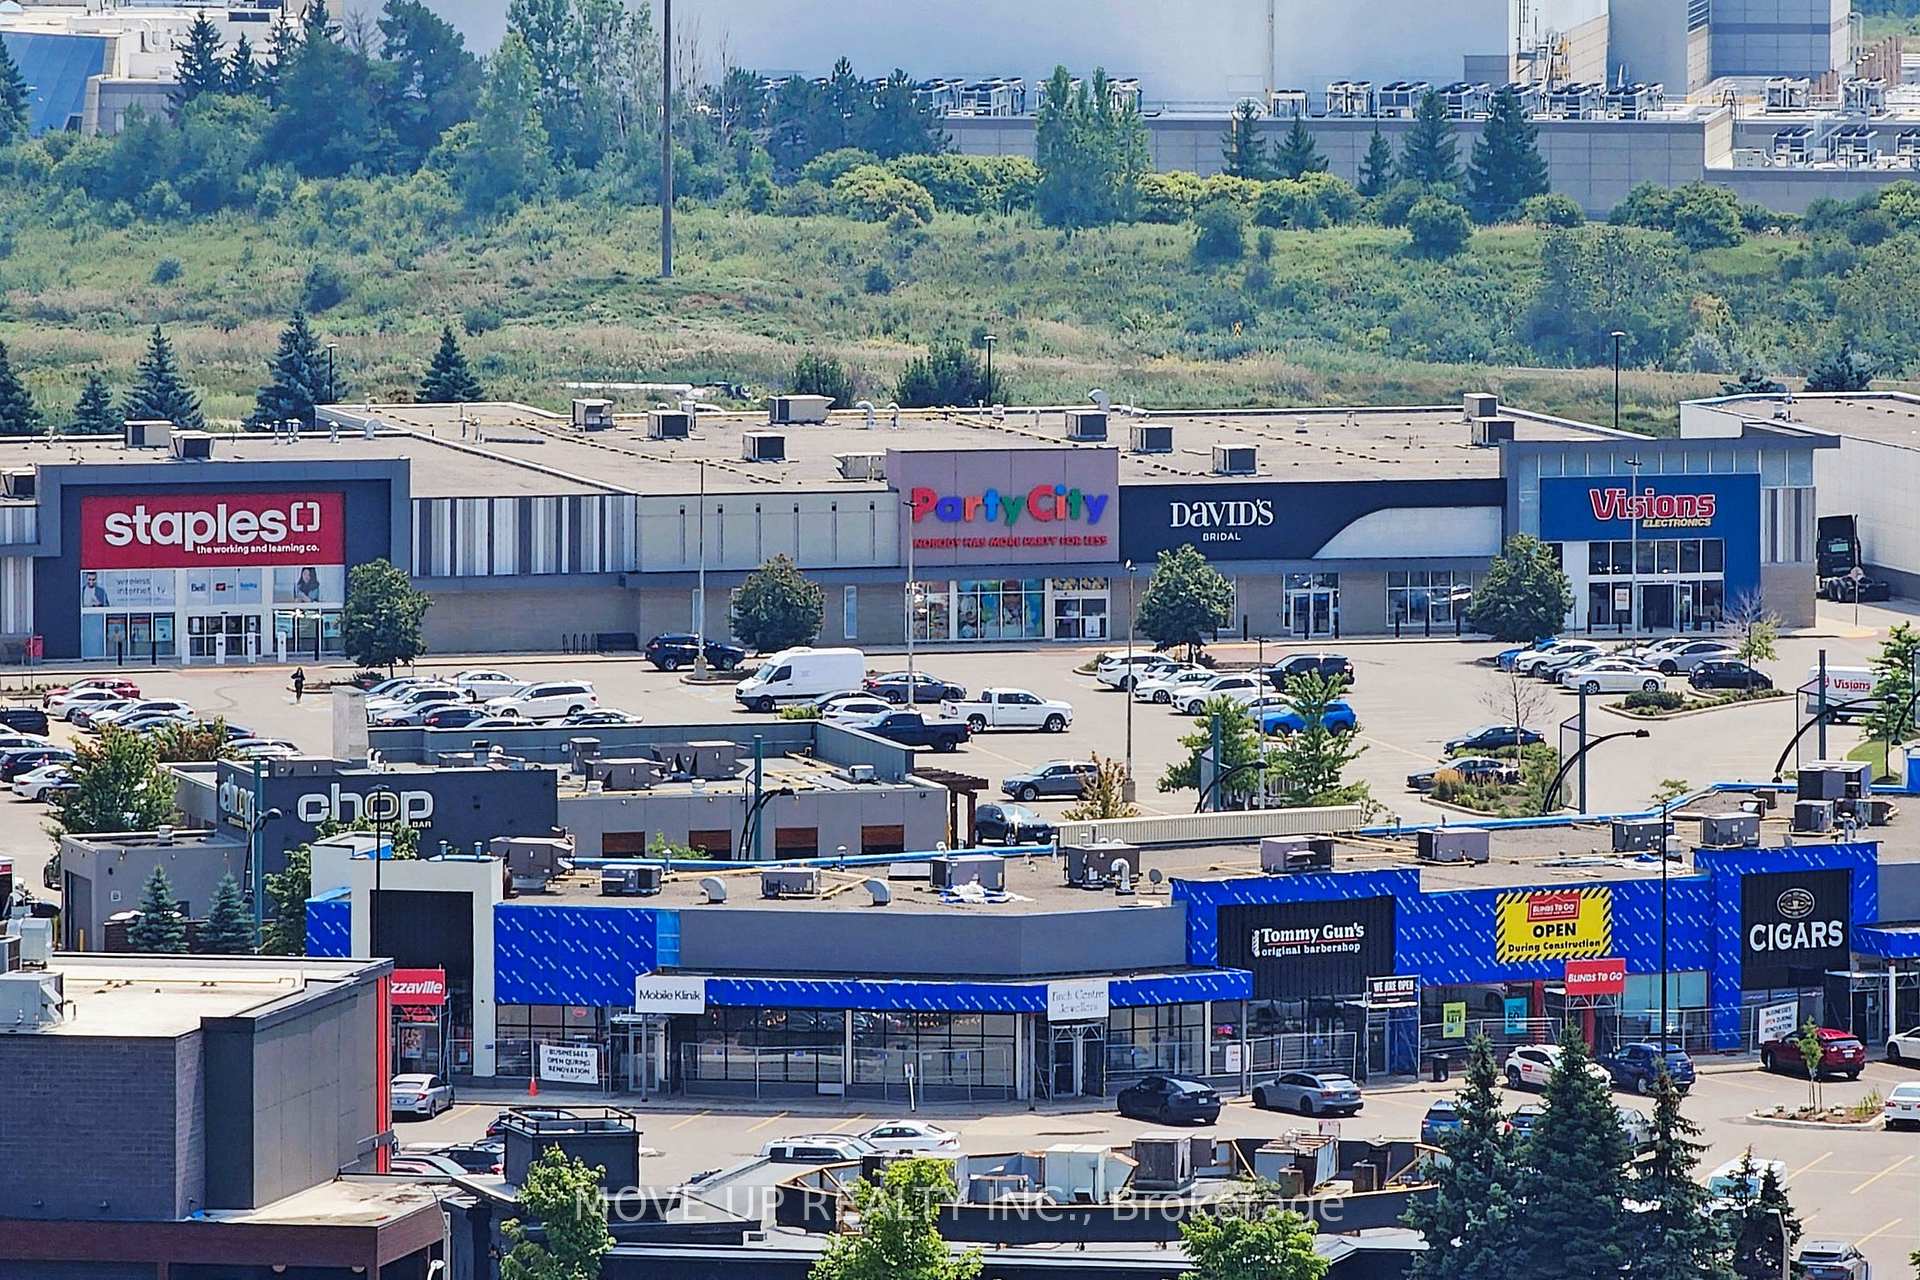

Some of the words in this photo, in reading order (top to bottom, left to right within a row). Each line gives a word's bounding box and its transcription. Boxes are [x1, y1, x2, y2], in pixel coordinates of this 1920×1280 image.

[1589, 488, 1715, 520] Visions
[104, 504, 288, 551] staples
[1642, 518, 1711, 528] ELECTRONICS
[988, 537, 1020, 547] MORE
[1060, 536, 1081, 546] FOR
[1083, 535, 1109, 545] LESS
[1202, 532, 1241, 541] BRIDAL
[197, 543, 212, 553] the
[214, 544, 249, 554] working
[250, 543, 267, 552] and
[268, 543, 305, 554] learning
[306, 544, 320, 552] co.
[191, 583, 206, 592] Bell
[1834, 678, 1871, 690] Visions
[297, 783, 434, 829] chop
[1261, 927, 1320, 943] Tommy
[1322, 922, 1365, 939] Gun's
[1533, 922, 1576, 938] OPEN
[1749, 920, 1844, 951] CIGARS
[1261, 945, 1301, 957] original
[1303, 943, 1361, 954] barbershop
[1508, 943, 1540, 952] During
[1543, 938, 1600, 950] Construction
[1567, 972, 1597, 983] BLINDS
[1597, 972, 1608, 981] TO
[1609, 971, 1623, 980] GO
[391, 980, 442, 994] zzaville
[1373, 981, 1383, 992] WE
[1384, 980, 1397, 991] ARE
[1397, 979, 1414, 991] OPEN
[639, 989, 673, 1000] Mobile
[674, 990, 701, 1000] Klinik
[549, 1049, 588, 1057] BUSINESSES
[548, 1065, 590, 1074] RENOVATION
